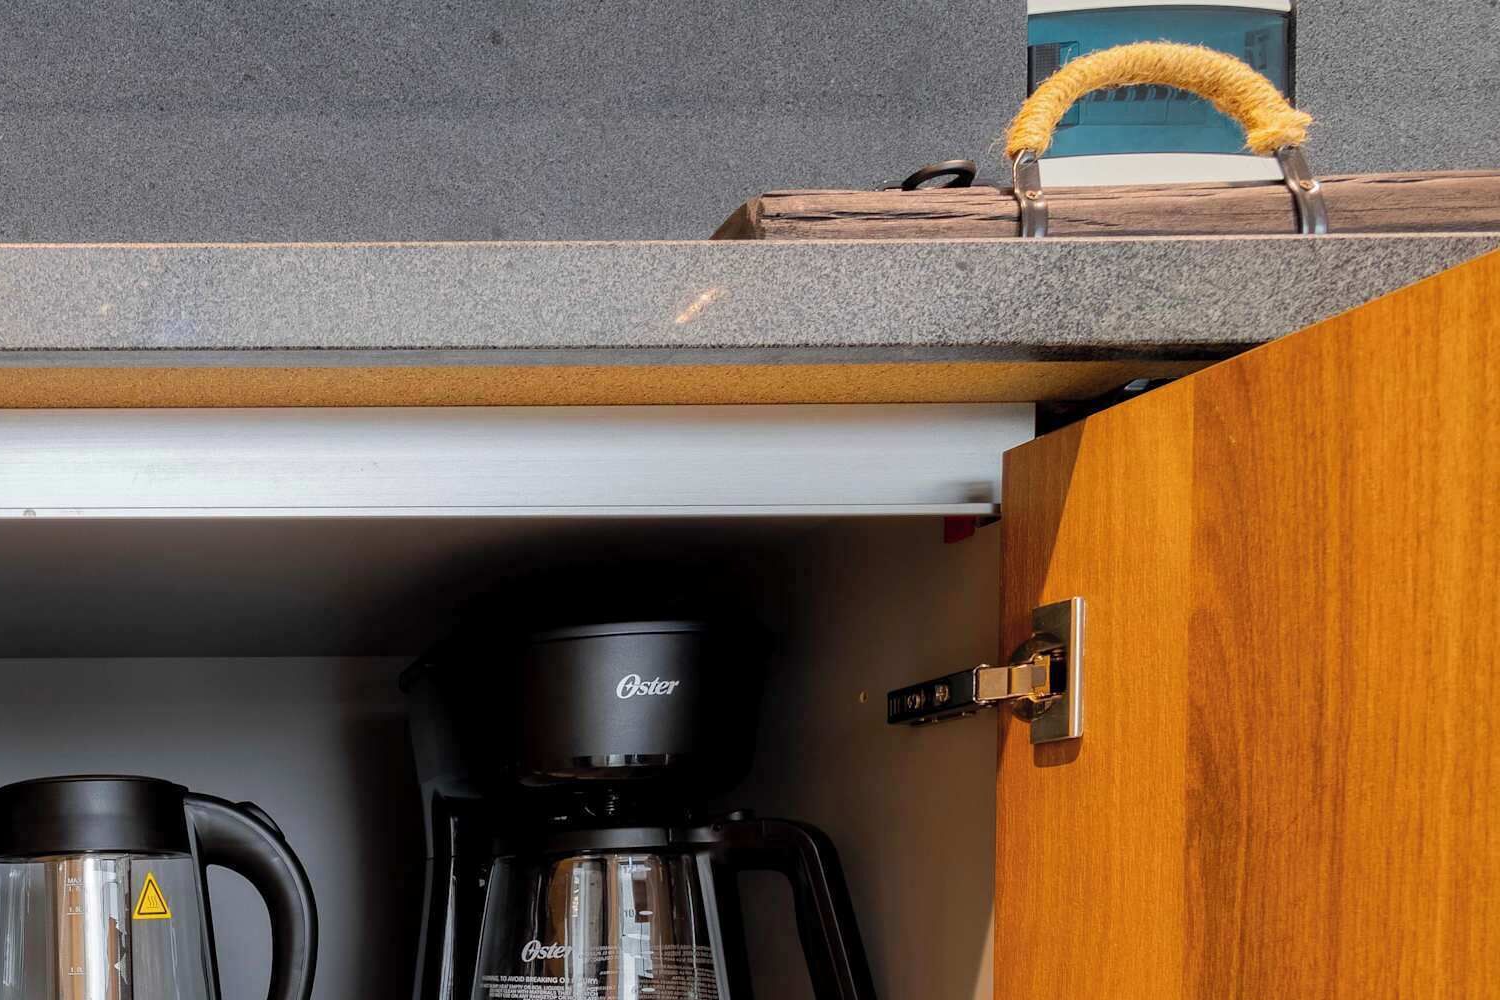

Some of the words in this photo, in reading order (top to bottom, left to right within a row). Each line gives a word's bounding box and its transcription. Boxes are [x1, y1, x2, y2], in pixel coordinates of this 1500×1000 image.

[616, 673, 680, 699] Oster
[521, 939, 573, 962] Oster
[507, 975, 525, 983] AVOID
[525, 976, 558, 984] BREAKING
